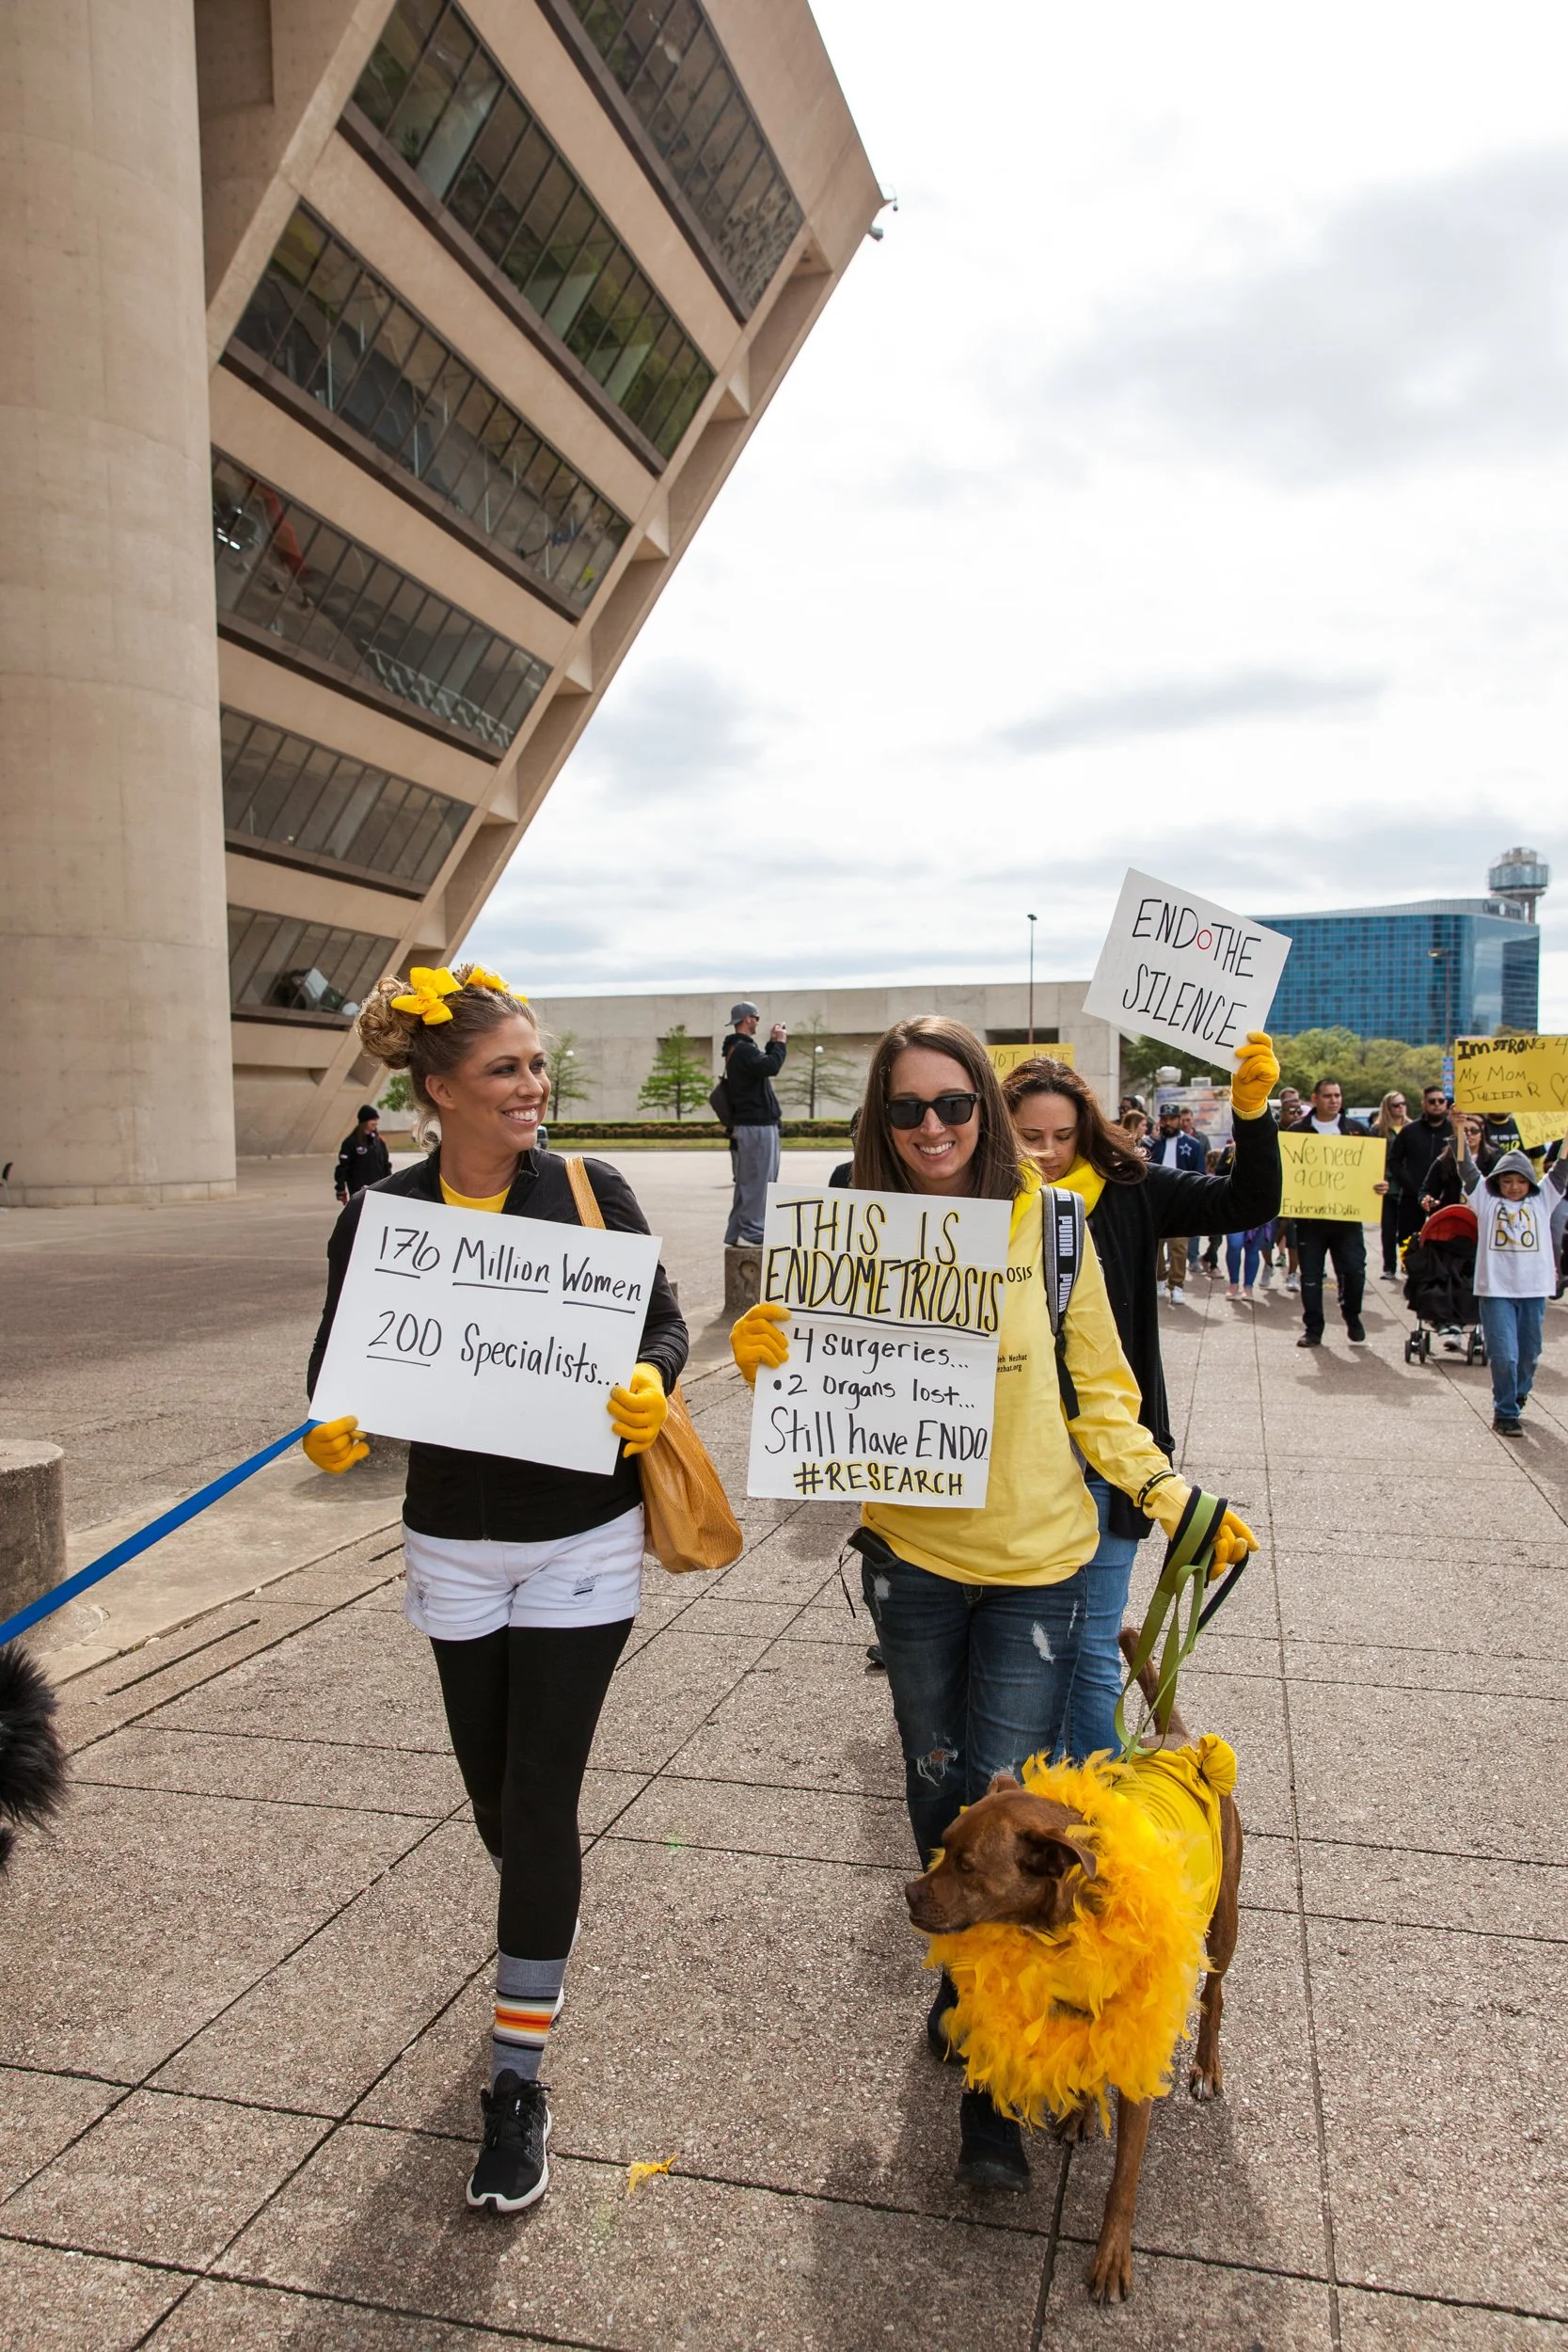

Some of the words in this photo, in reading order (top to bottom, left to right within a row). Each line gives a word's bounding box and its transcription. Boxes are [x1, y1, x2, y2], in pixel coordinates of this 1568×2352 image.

[1122, 963, 1248, 1049] SILENCE
[1493, 1038, 1545, 1055] STRONG
[1528, 1082, 1541, 1098] R
[1283, 1137, 1318, 1166] We
[1323, 1139, 1365, 1167] need
[1294, 1168, 1306, 1185] a
[1308, 1170, 1346, 1190] cure
[775, 1200, 886, 1256] THIS
[920, 1211, 959, 1265] IS
[1058, 1215, 1074, 1257] PUMA
[380, 1226, 440, 1272] 176
[452, 1236, 550, 1284] Million
[562, 1253, 641, 1302] Women
[765, 1246, 1005, 1332] ENDOMETRIOSIS
[368, 1311, 442, 1357] 200
[794, 1327, 814, 1362] 4
[823, 1375, 895, 1410] organs
[765, 1406, 835, 1457] Still
[848, 1412, 909, 1455] have
[793, 1461, 963, 1497] #RESEARCH
